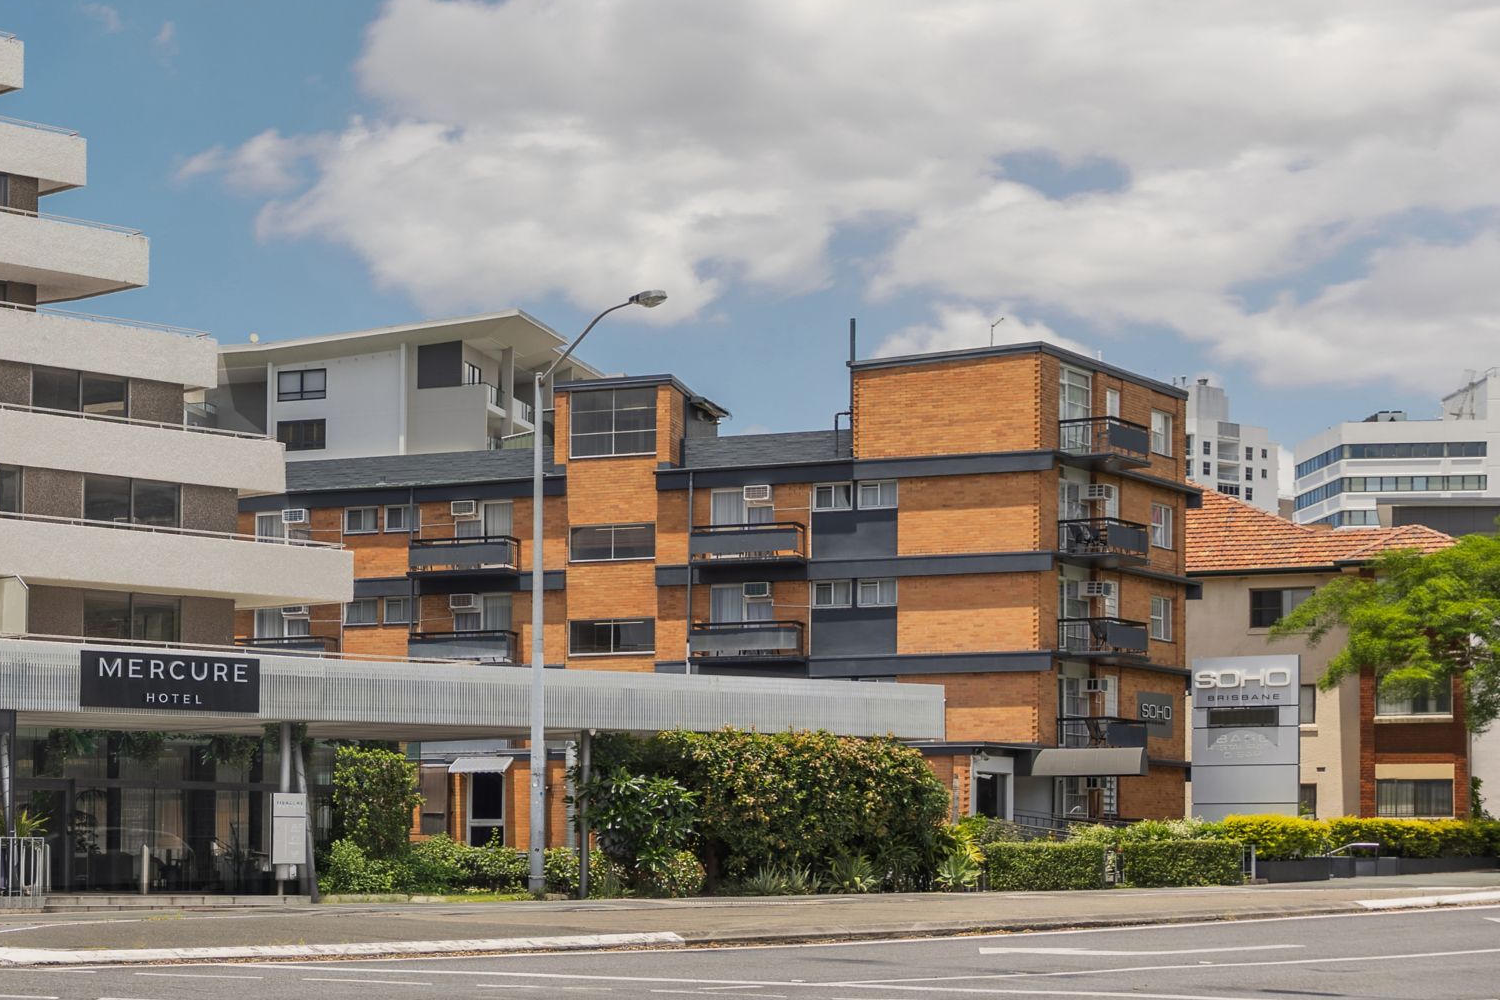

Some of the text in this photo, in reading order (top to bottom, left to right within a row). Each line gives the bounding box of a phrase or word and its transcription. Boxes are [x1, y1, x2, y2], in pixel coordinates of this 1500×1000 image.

[99, 657, 249, 683] MERCURE
[1194, 668, 1291, 689] SOHO
[146, 692, 202, 705] HOTEL
[1207, 693, 1281, 702] BRISBANE
[1140, 703, 1172, 720] SOHO
